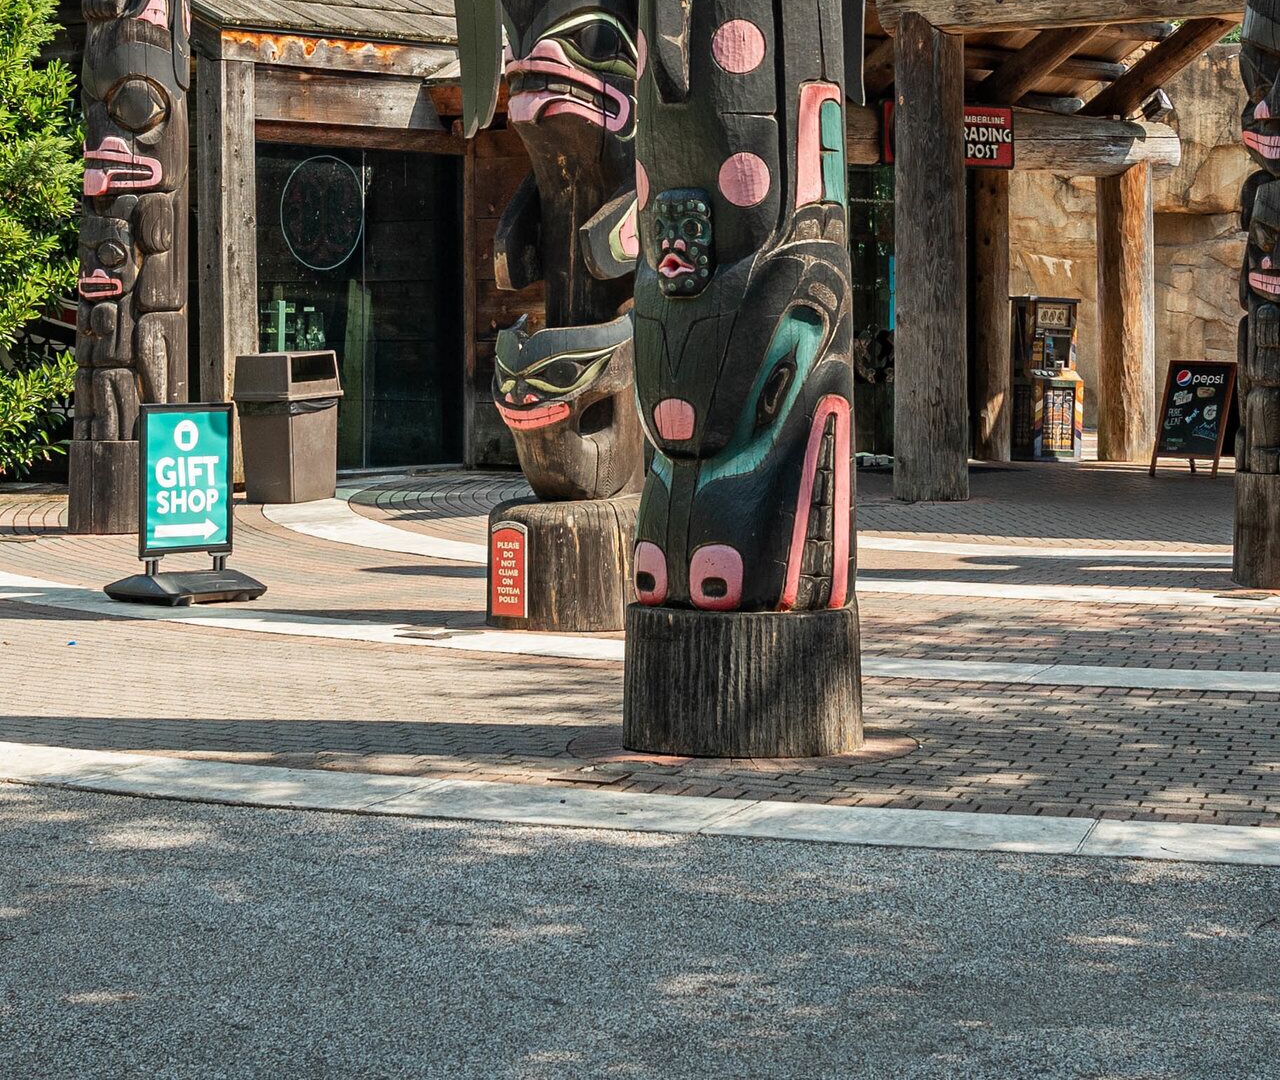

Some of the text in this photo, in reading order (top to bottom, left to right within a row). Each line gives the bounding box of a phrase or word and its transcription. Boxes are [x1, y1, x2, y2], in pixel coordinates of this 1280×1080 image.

[964, 115, 1006, 125] MBERLINE
[964, 126, 1012, 143] RADING
[967, 143, 999, 159] POST
[1192, 373, 1225, 385] pepsi
[155, 455, 219, 488] GIFT
[156, 488, 219, 515] SHOP
[497, 541, 520, 549] PLEASE
[501, 560, 516, 568] NOT
[498, 569, 518, 577] CLIMB
[497, 587, 520, 595] TOTEM
[499, 596, 518, 604] POLES
